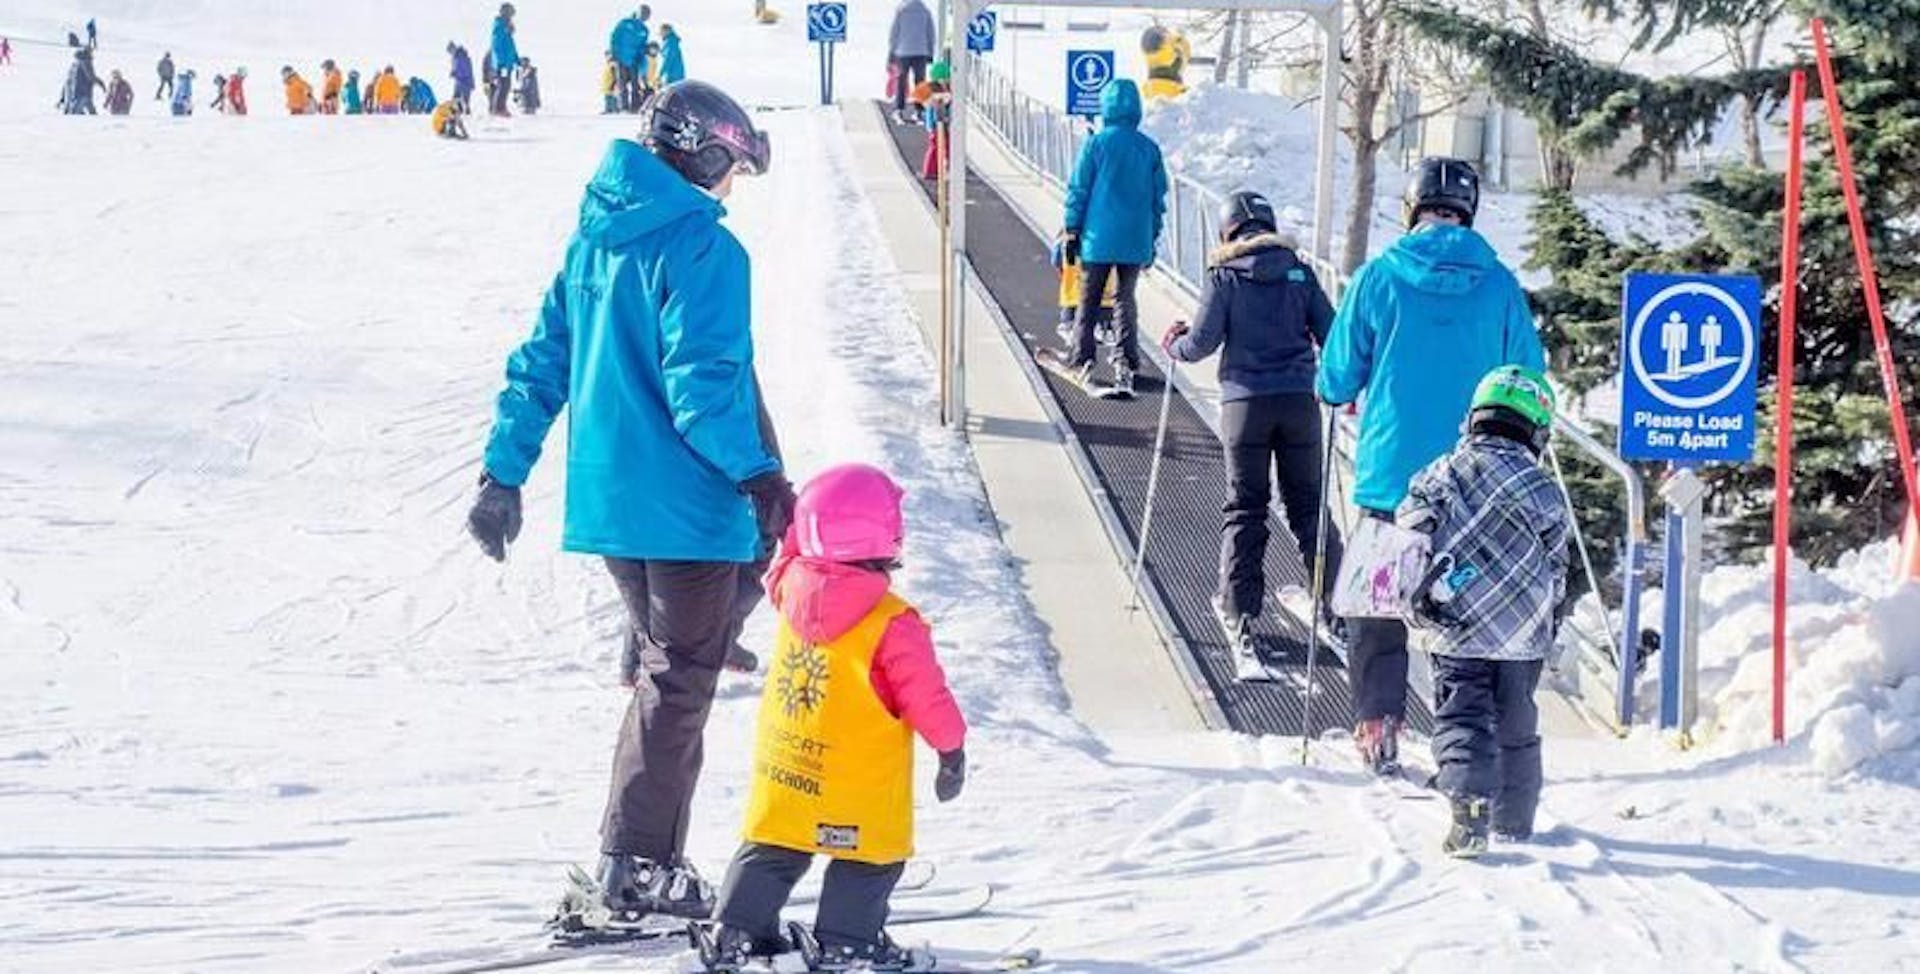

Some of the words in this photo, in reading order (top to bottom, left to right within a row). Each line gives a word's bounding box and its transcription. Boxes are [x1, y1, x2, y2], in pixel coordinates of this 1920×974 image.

[1633, 411, 1693, 429] Please
[1698, 413, 1743, 430] Load
[1647, 430, 1675, 447] 5m
[1679, 430, 1728, 450] Apart
[770, 765, 822, 797] SCHOOL
